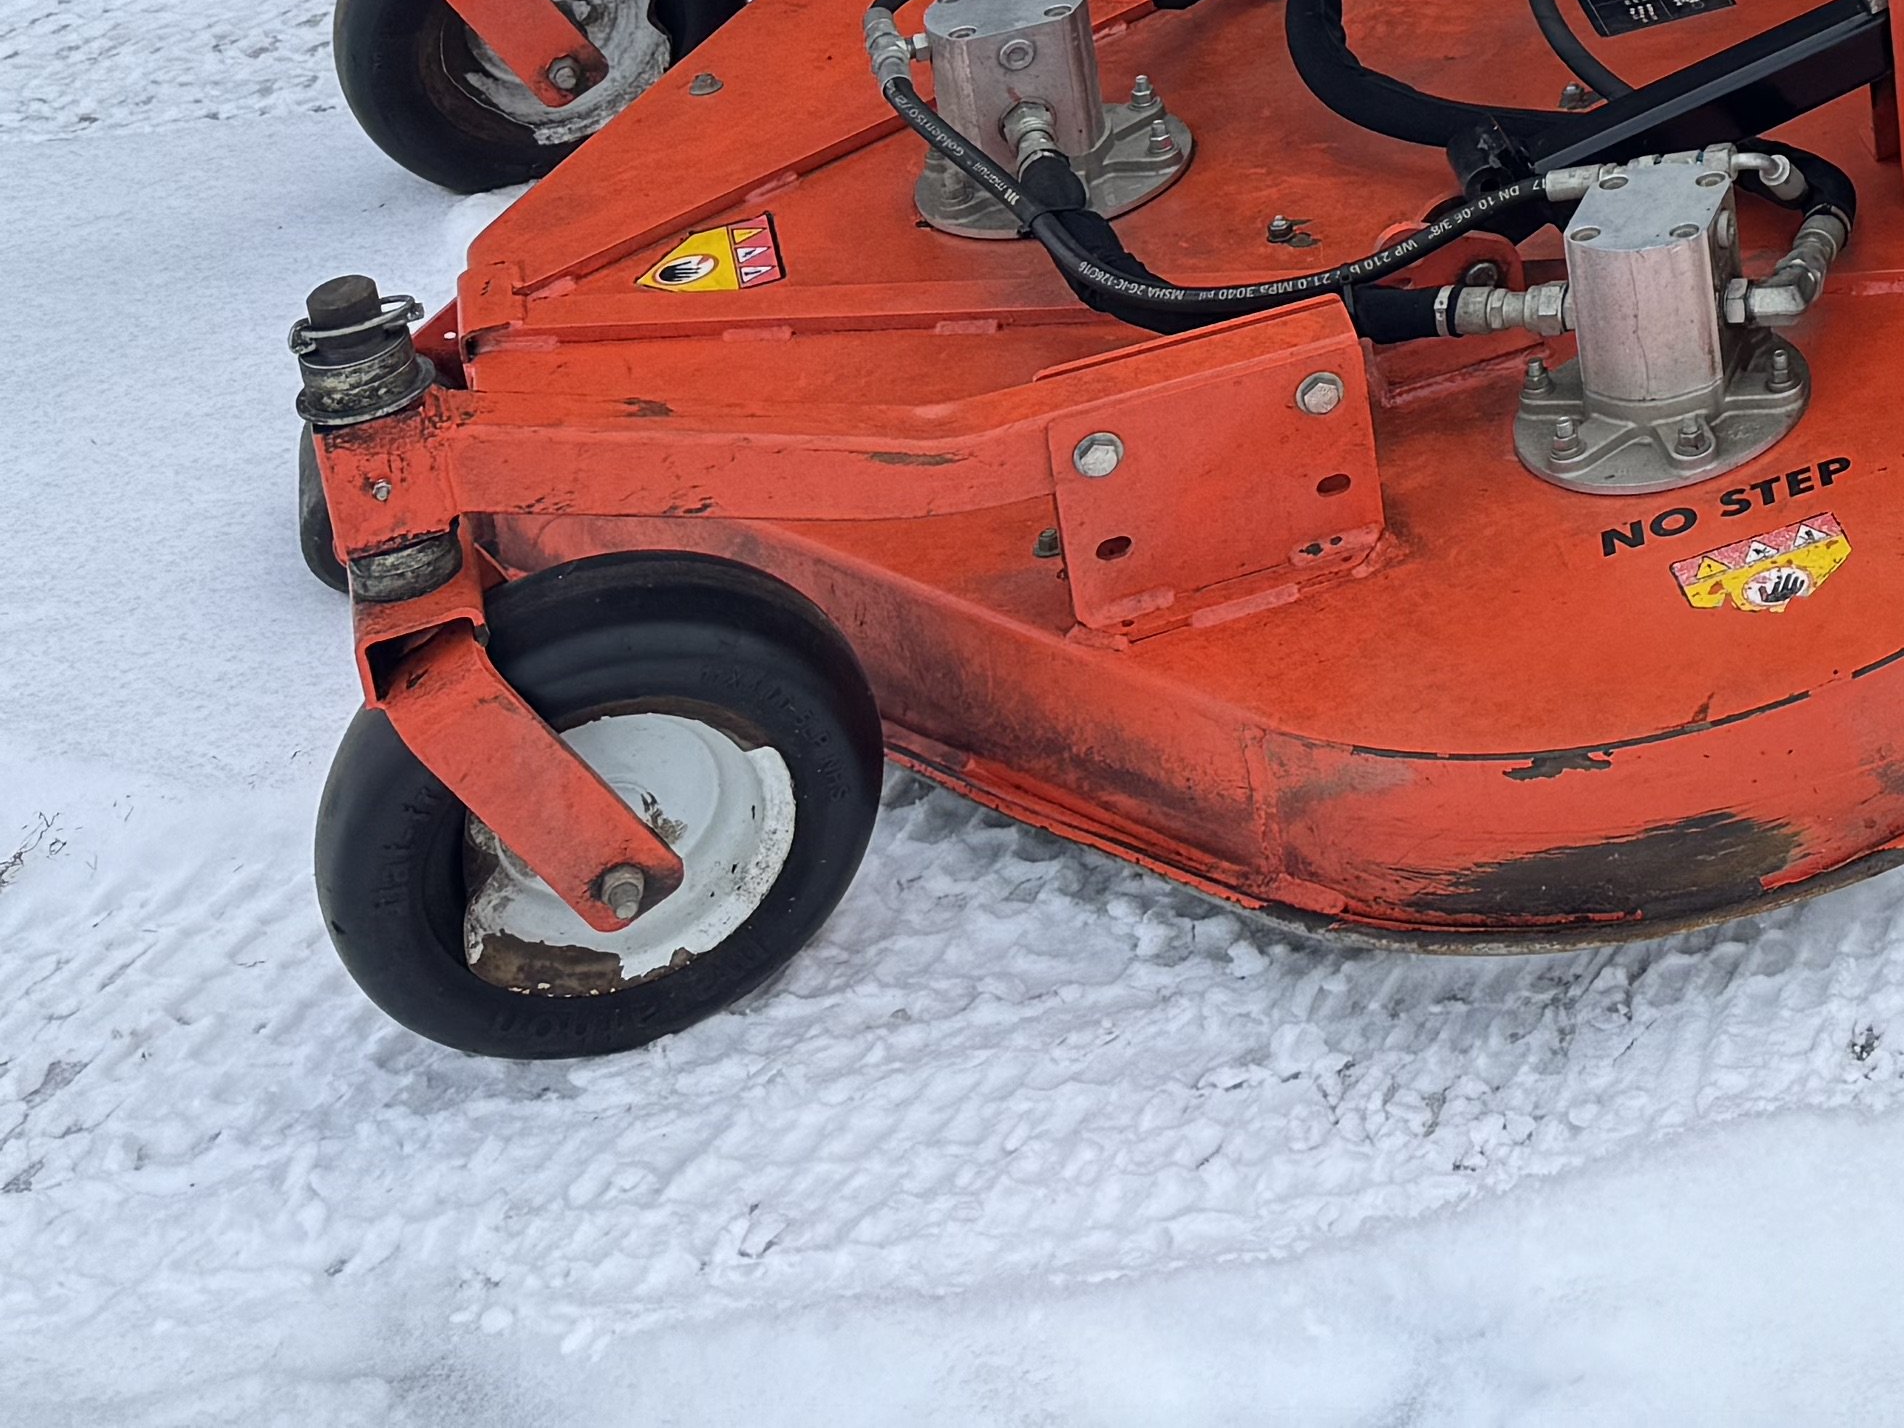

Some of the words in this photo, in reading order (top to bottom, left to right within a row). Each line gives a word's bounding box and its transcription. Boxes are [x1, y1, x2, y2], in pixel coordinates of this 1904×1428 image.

[1498, 185, 1520, 201] DN
[1478, 195, 1496, 210] 10
[1395, 239, 1418, 257] WP
[1364, 252, 1391, 271] 210
[1260, 282, 1293, 295] MPa
[1297, 272, 1331, 290] 21.0
[1147, 286, 1185, 300] MSHA
[1219, 287, 1255, 300] 3040
[1601, 507, 1698, 557] NO
[1720, 456, 1851, 518] STEP
